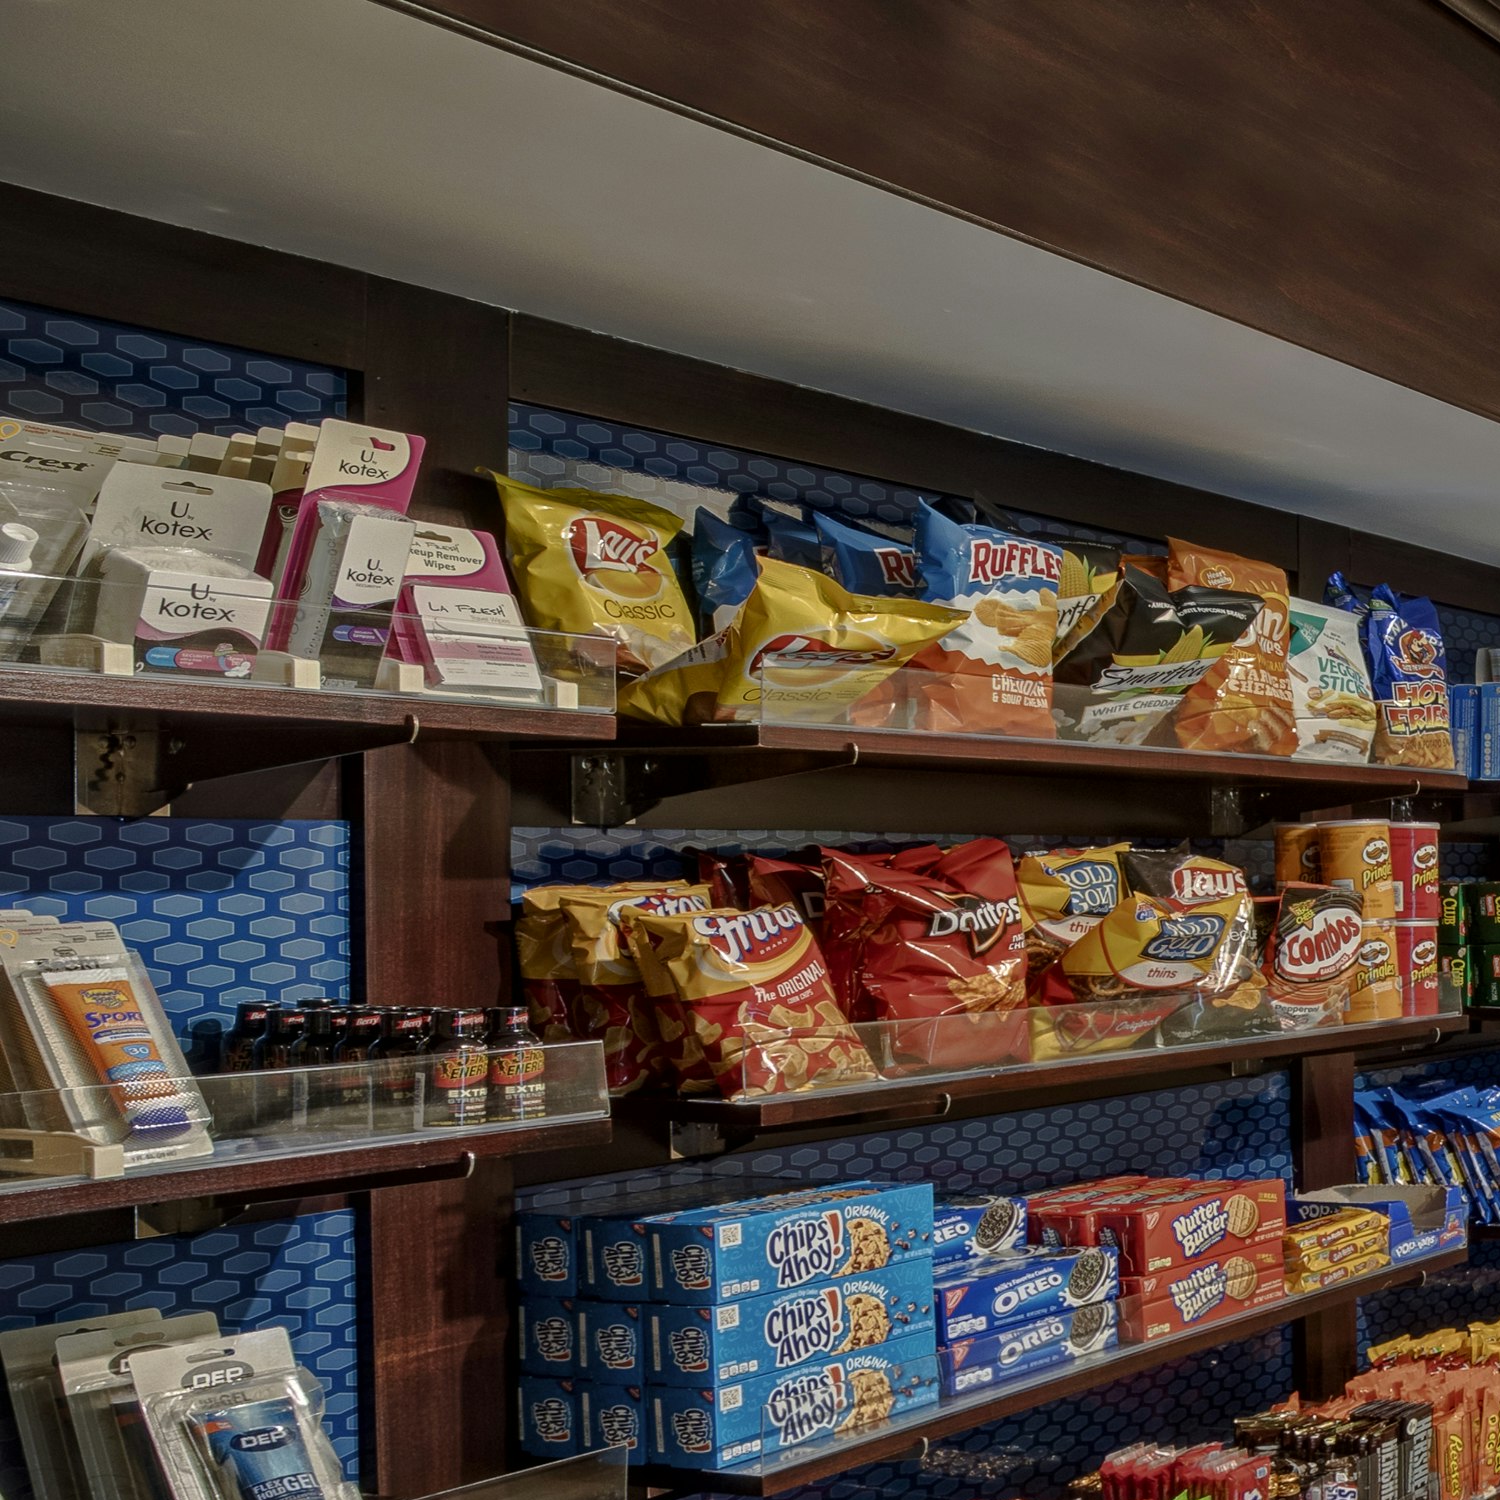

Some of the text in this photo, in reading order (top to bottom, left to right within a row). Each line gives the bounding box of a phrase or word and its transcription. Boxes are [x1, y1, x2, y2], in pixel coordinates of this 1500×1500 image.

[1, 451, 91, 472] Crest
[361, 450, 375, 464] U
[338, 459, 388, 480] kotex
[171, 501, 189, 519] U
[140, 516, 212, 541] kotex
[584, 520, 660, 574] Lay's
[367, 558, 380, 571] U
[423, 558, 457, 572] Wipes
[436, 551, 483, 566] Remover
[970, 540, 1063, 583] RUFFLES
[347, 568, 394, 586] kotex
[191, 583, 210, 600] U
[158, 598, 235, 623] kotex
[455, 603, 506, 618] FRESH
[602, 599, 676, 621] Classic
[1317, 656, 1365, 685] VEGGIE
[742, 687, 831, 703] Classic
[991, 673, 1047, 698] CHEDDAR
[1395, 681, 1448, 707] HOT
[1001, 694, 1049, 710] SOUR CREAM
[1092, 704, 1131, 718] WHITE
[1059, 863, 1115, 891] ROLD
[1181, 868, 1248, 899] Lay's
[929, 896, 1023, 939] Doritos
[1443, 898, 1457, 926] CLUB
[693, 902, 804, 963] Fritos
[1286, 914, 1361, 967] Combos
[758, 936, 789, 956] BRAND
[1147, 934, 1216, 956] GOLD
[754, 959, 826, 1004] The ORIGINAL
[1147, 967, 1178, 980] thins
[1356, 963, 1396, 991] Pringles
[84, 1011, 145, 1030] SPORT
[357, 1016, 379, 1026] Berry
[403, 1017, 423, 1028] Berry
[1115, 1015, 1162, 1032] Original
[128, 1046, 149, 1056] 30
[844, 1205, 890, 1226] ORIGINAL
[942, 1215, 962, 1225] Cookie
[1172, 1199, 1222, 1241] Nutter
[768, 1217, 830, 1266] Chips
[1181, 1211, 1229, 1258] Butter
[842, 1280, 889, 1300] ORIGINAL
[994, 1266, 1055, 1294] Milk's Favorite Cookie
[994, 1273, 1063, 1316] OREO
[1178, 1274, 1228, 1322] Butter
[766, 1297, 828, 1347] Chips
[999, 1325, 1065, 1366] OREO
[192, 1366, 244, 1389] DEP
[240, 1430, 288, 1449] DEP
[1449, 1435, 1464, 1497] Reese's
[252, 1473, 318, 1495] FLEX GEL
